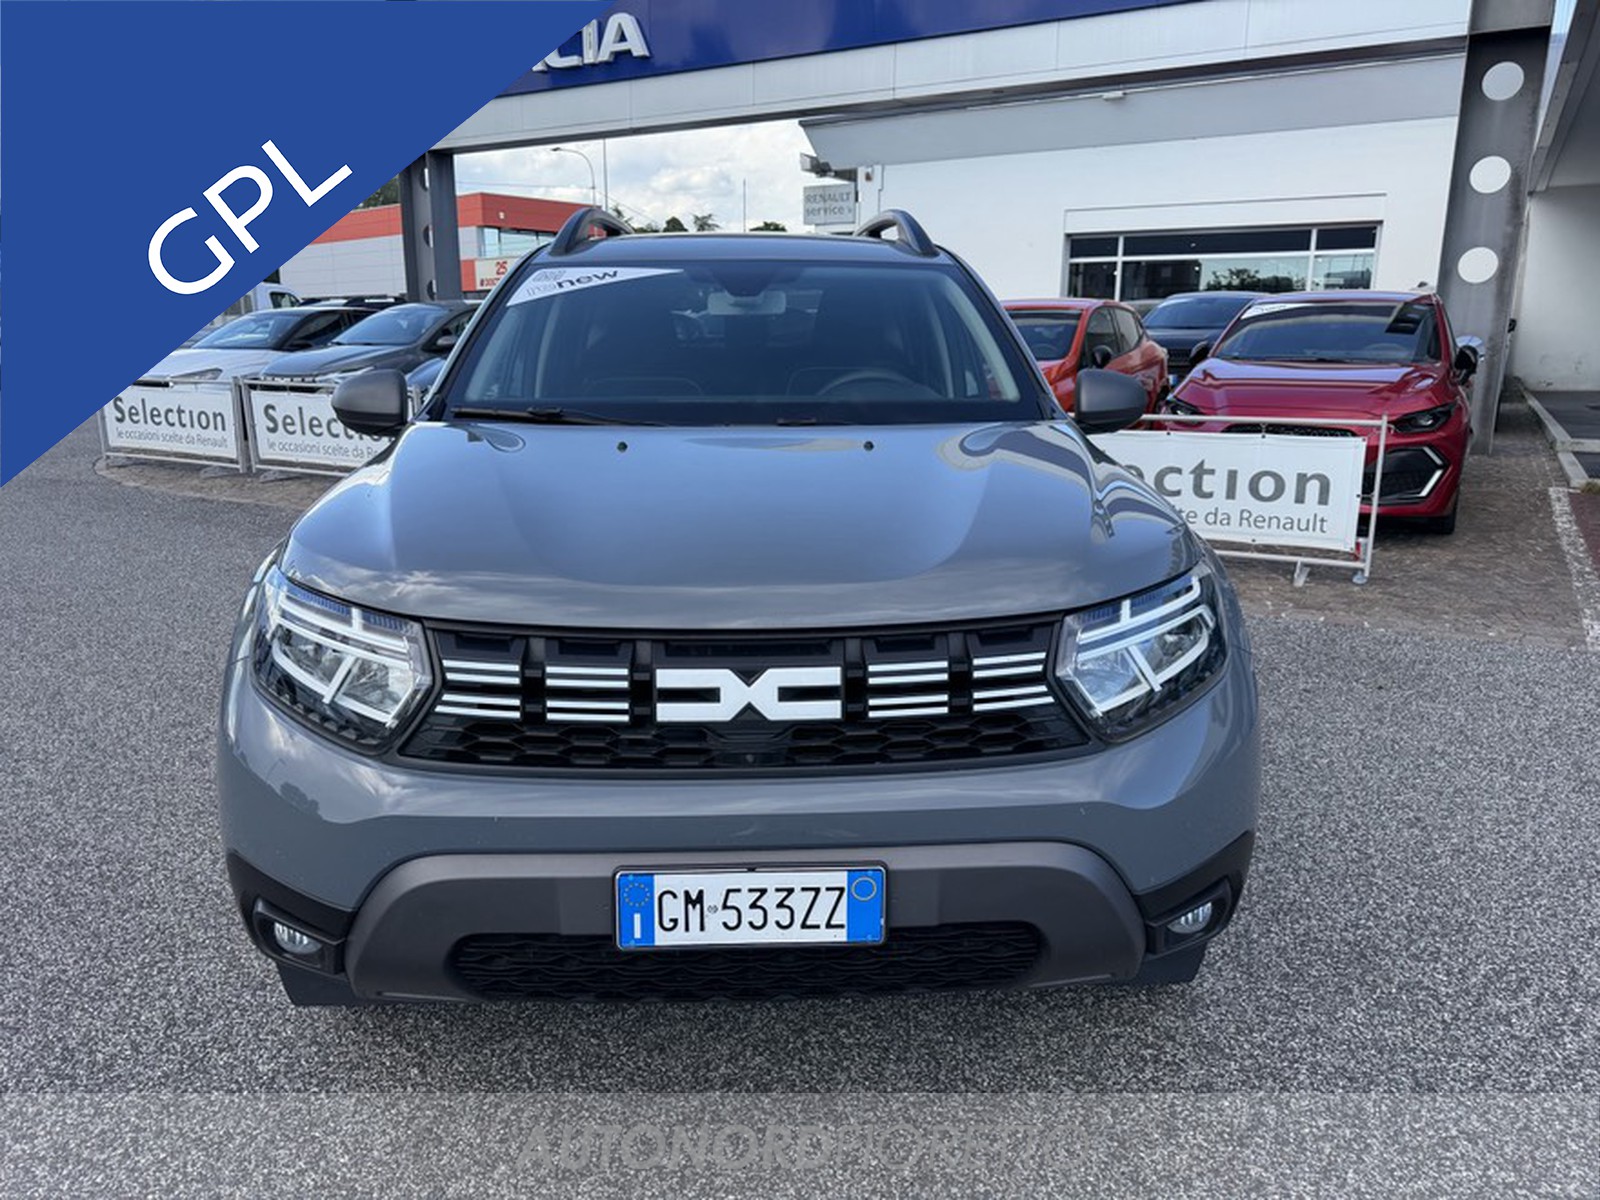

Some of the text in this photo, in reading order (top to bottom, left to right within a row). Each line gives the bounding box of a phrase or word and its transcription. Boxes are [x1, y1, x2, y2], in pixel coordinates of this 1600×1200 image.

[806, 206, 845, 216] service
[113, 396, 226, 431] Selection
[263, 403, 396, 442] Selec
[196, 434, 229, 448] Renault
[351, 445, 365, 458] da
[1124, 459, 1331, 505] ction
[1204, 507, 1231, 526] da
[1239, 509, 1328, 533] Renault
[657, 887, 846, 932] GM 533ZZ
